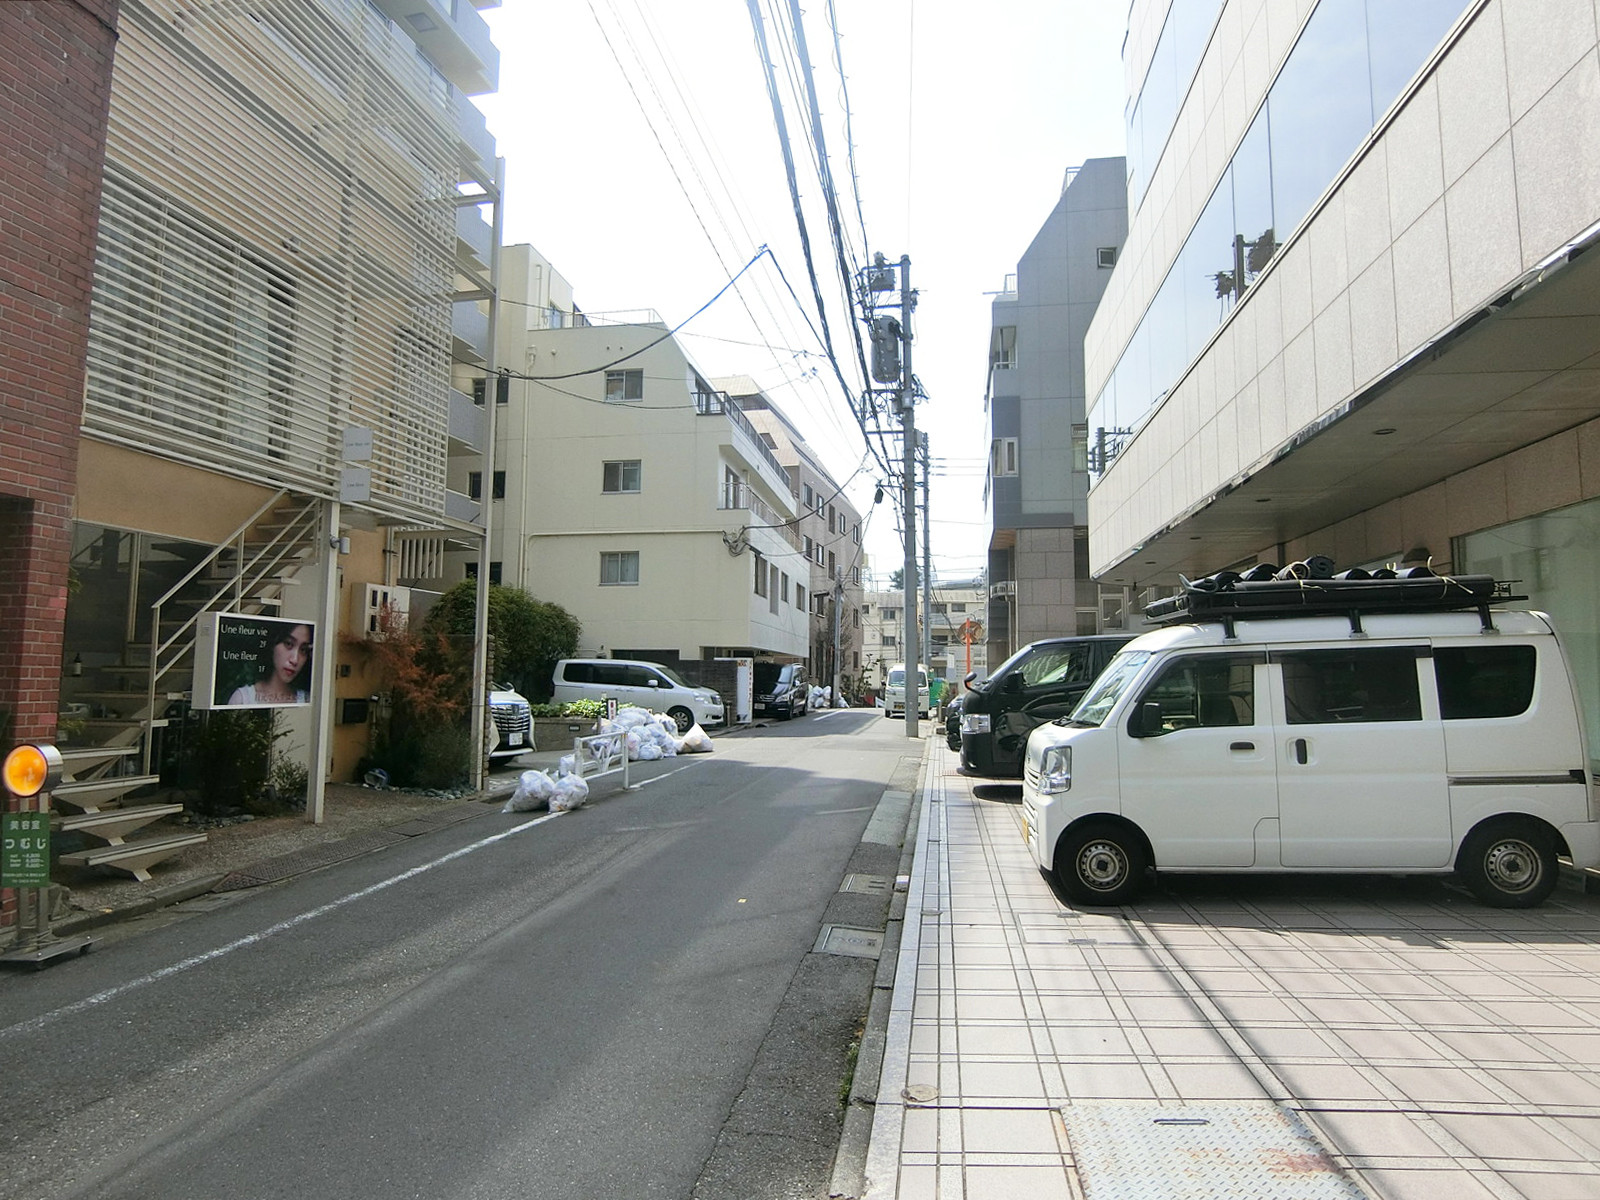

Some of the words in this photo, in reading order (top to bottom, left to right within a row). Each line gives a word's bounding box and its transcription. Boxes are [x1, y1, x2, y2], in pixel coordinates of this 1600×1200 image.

[221, 624, 238, 634] Une
[238, 625, 256, 636] fleur
[256, 627, 268, 637] vie
[223, 650, 240, 660] Une
[240, 651, 258, 661] fleur
[10, 820, 40, 830] 美容室
[5, 838, 47, 850] つむじ
